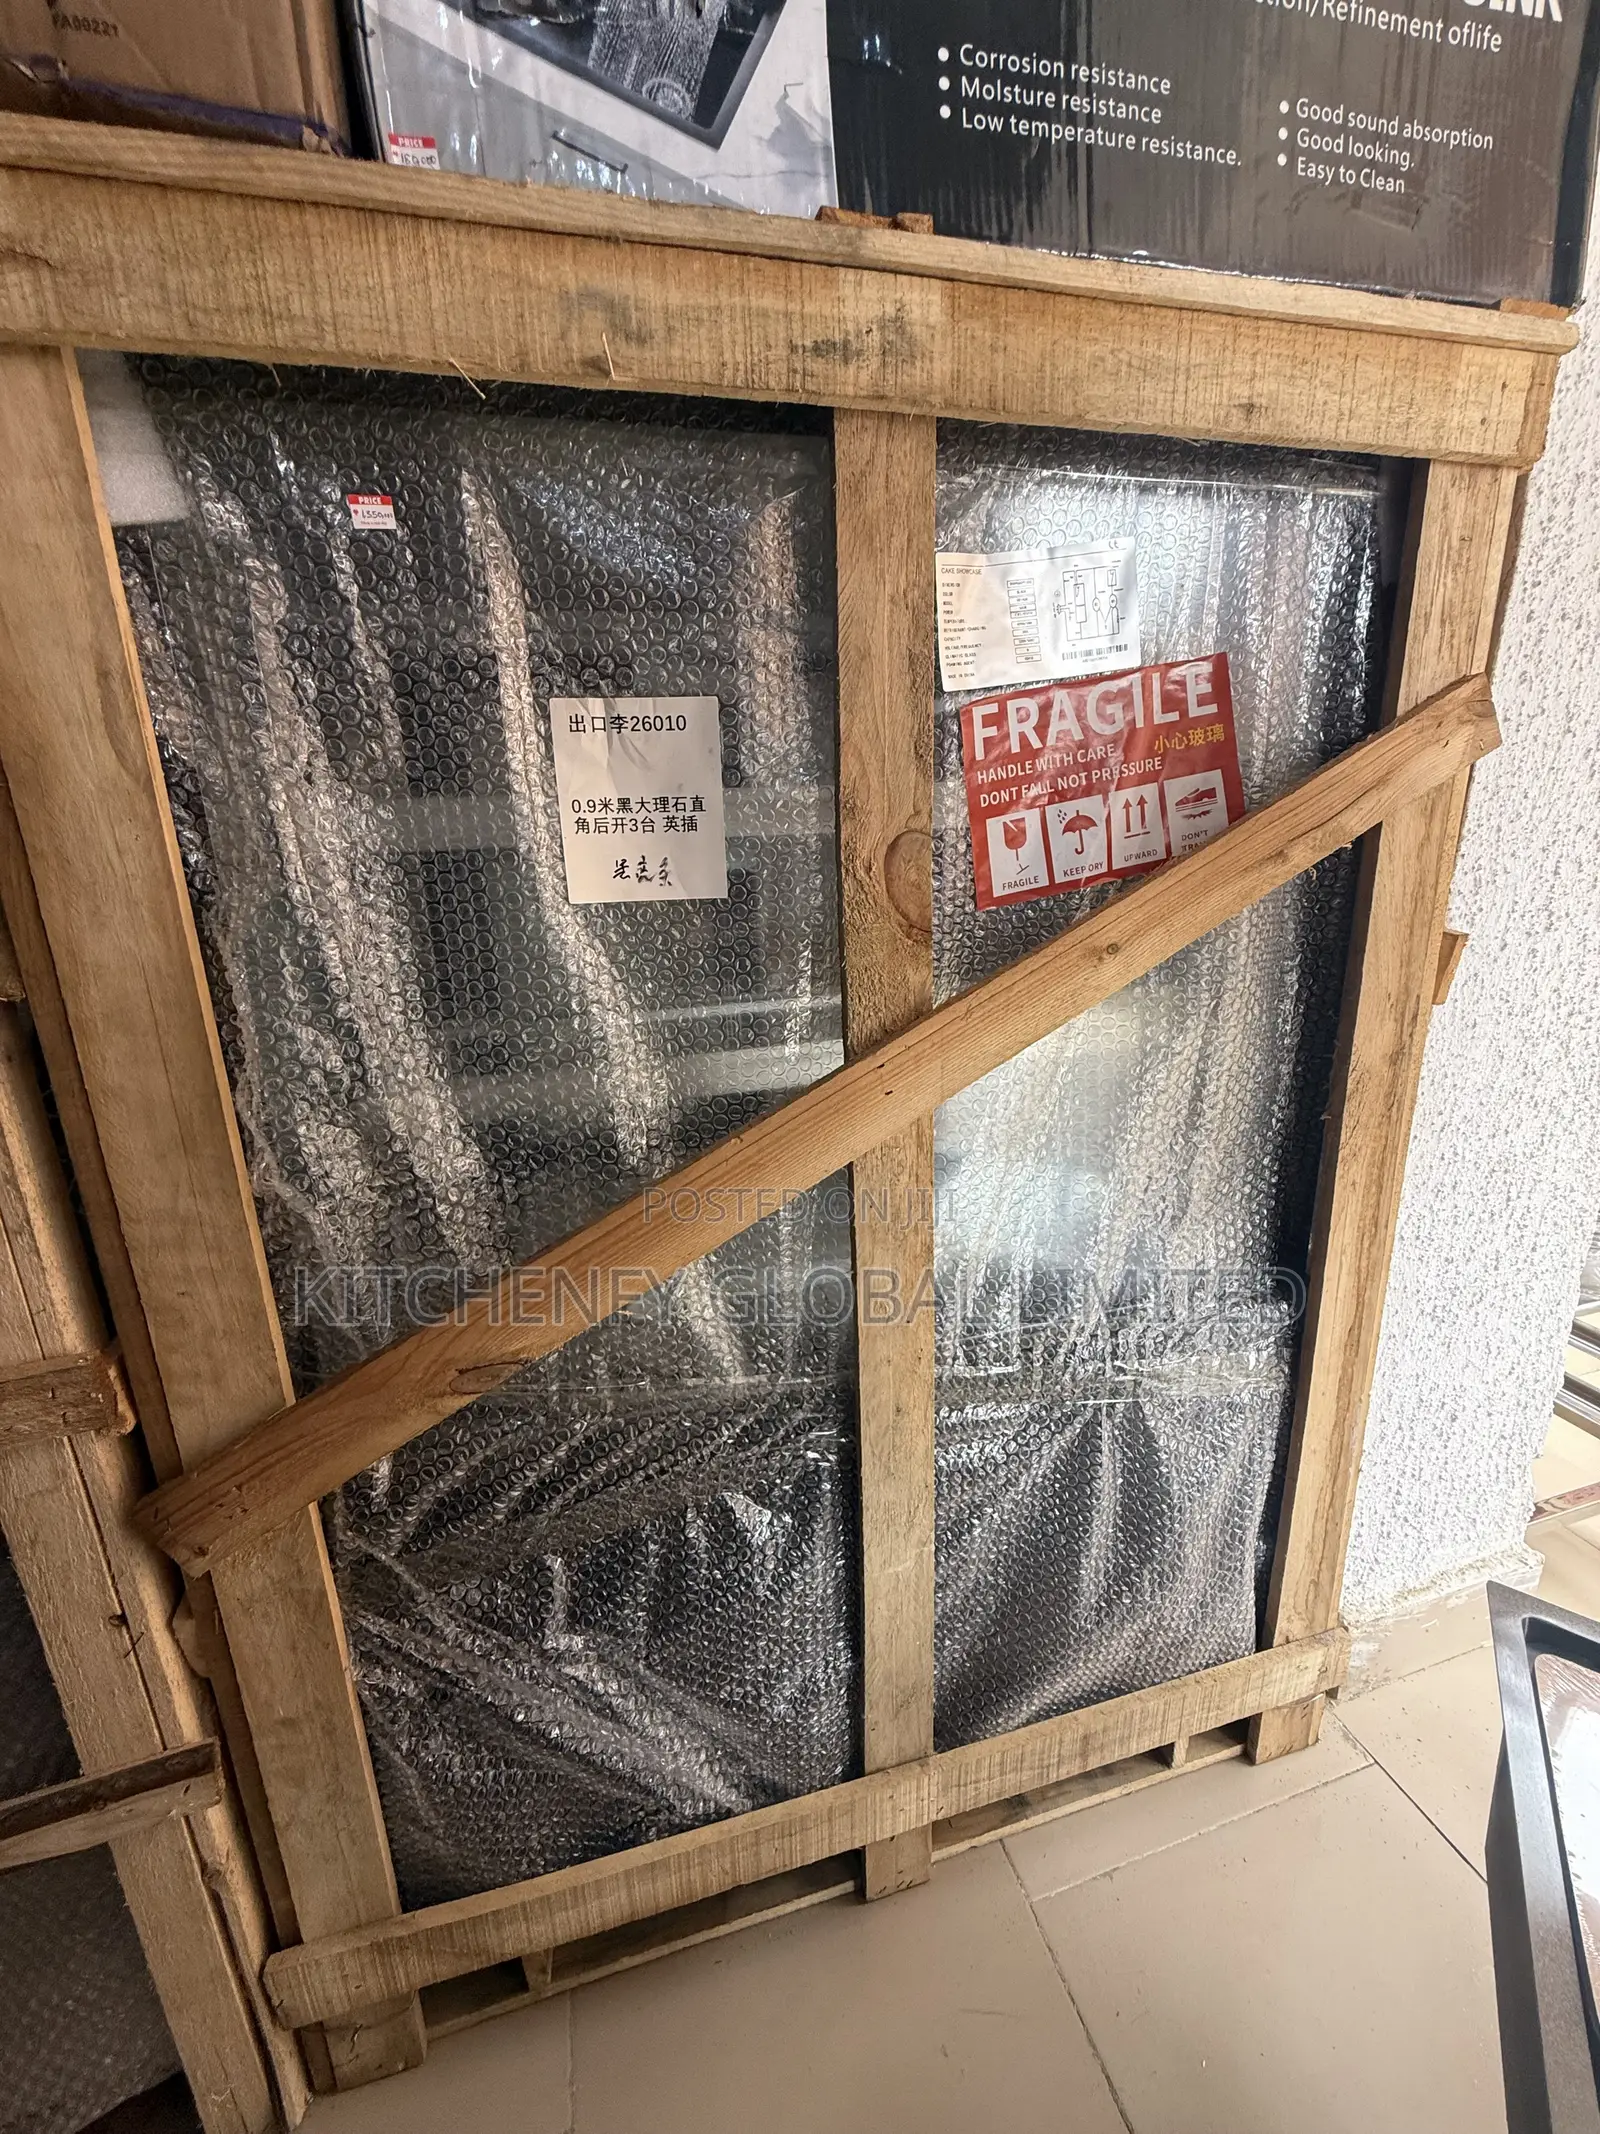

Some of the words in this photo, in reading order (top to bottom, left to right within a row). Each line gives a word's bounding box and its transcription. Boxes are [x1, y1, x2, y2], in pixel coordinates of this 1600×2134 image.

[1448, 20, 1503, 52] oflife
[960, 43, 1064, 79] Corrosion
[1071, 62, 1171, 95] resistance
[1062, 92, 1162, 124] resistance
[1296, 98, 1343, 124] Good
[1348, 111, 1399, 136] sound
[1402, 119, 1493, 150] absorption
[962, 107, 1004, 132] Low
[1009, 114, 1136, 150] temperature
[1141, 135, 1242, 167] resistance.
[1297, 128, 1344, 154] Good
[1297, 156, 1335, 185] Easy
[1339, 164, 1356, 184] to
[1360, 168, 1405, 193] Clean
[358, 496, 382, 505] PRICE
[569, 714, 687, 734] 出口李26010
[971, 662, 1218, 760] FRAGILE
[1153, 723, 1225, 756] 小心玻璃
[977, 760, 1033, 785] HANDLE
[1035, 752, 1073, 772] WITH
[1077, 743, 1117, 764] CARE
[980, 786, 1018, 808] DONT
[1058, 772, 1088, 791] NOT
[1092, 757, 1162, 782] PRESSURE
[571, 795, 706, 814] 0.9米黑大理石直
[574, 817, 656, 834] 角后开3台
[663, 815, 698, 833] 英插
[1063, 865, 1086, 878] KEEP
[1123, 849, 1158, 862] UPWARD
[1002, 875, 1040, 891] FRAGILE
